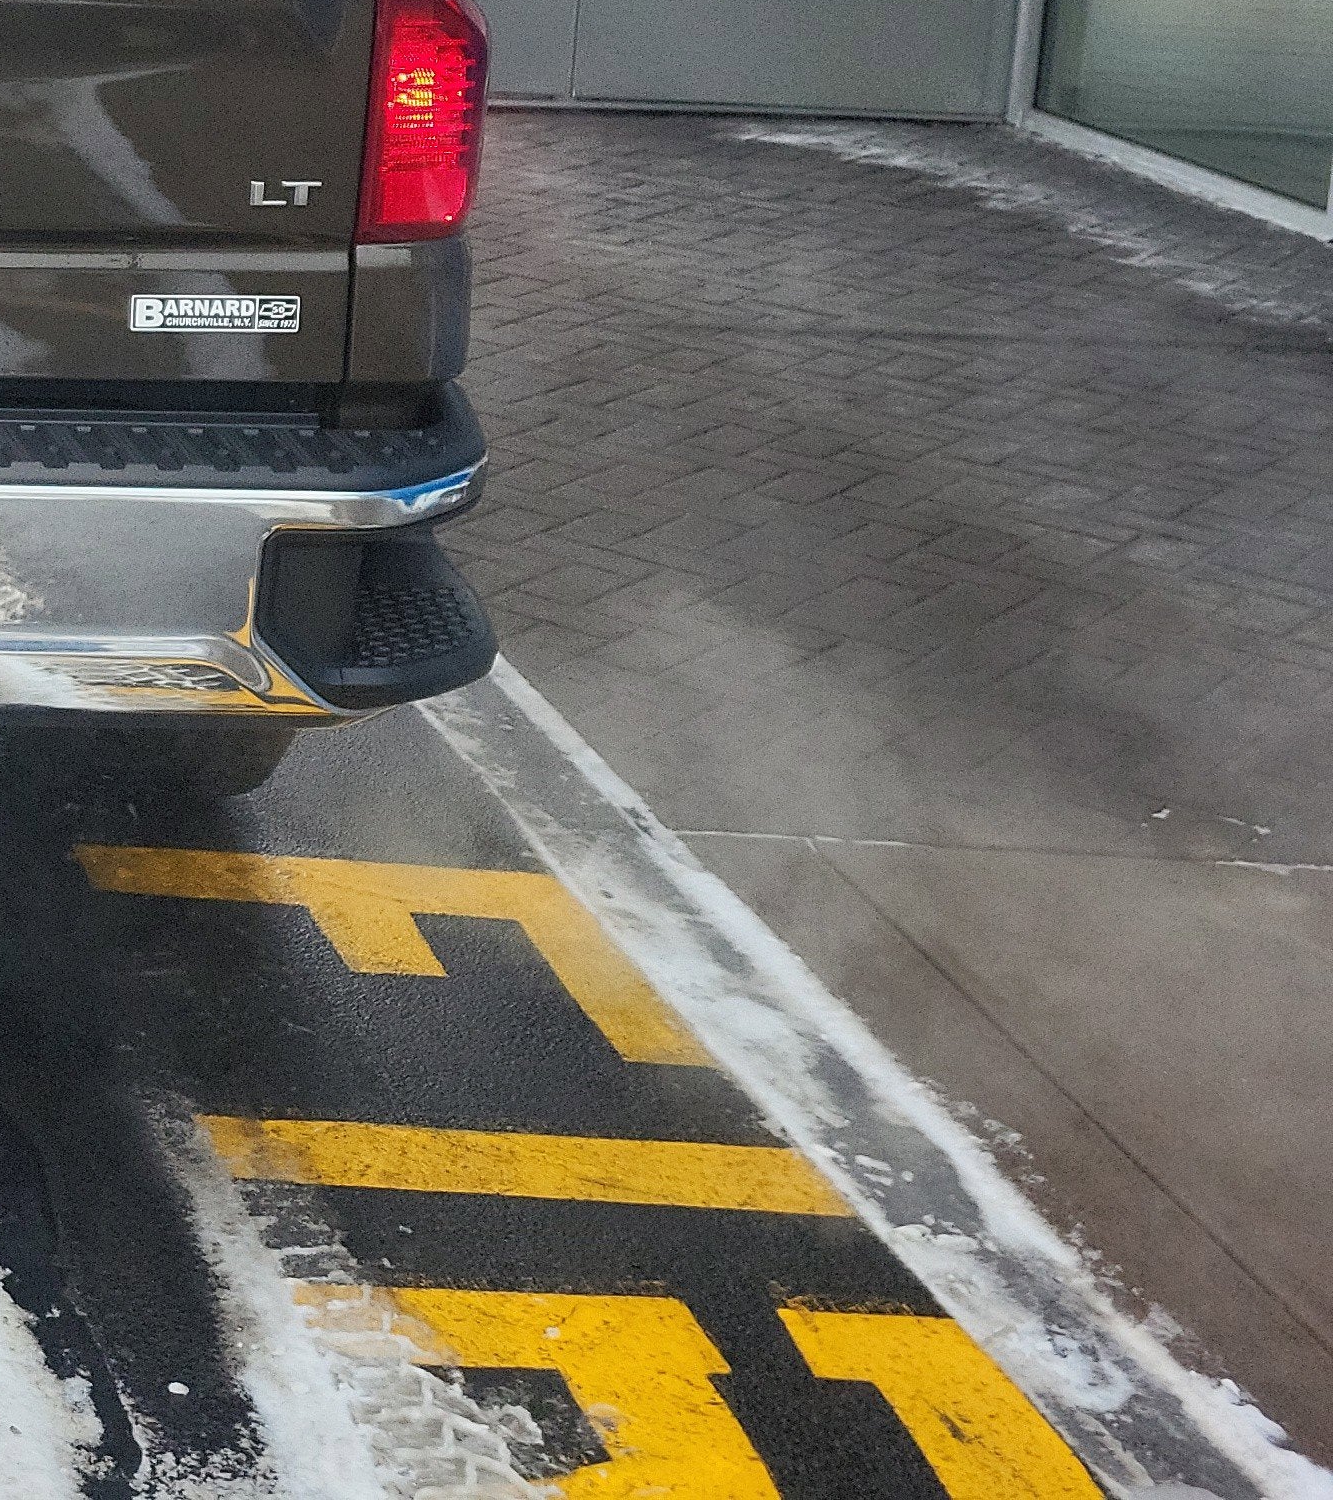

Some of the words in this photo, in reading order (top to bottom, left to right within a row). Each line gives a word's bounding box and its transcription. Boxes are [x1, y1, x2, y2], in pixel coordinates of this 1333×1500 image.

[249, 180, 323, 207] LT
[135, 299, 255, 327] BARNARD
[165, 317, 233, 328] CHURCHVILLE,
